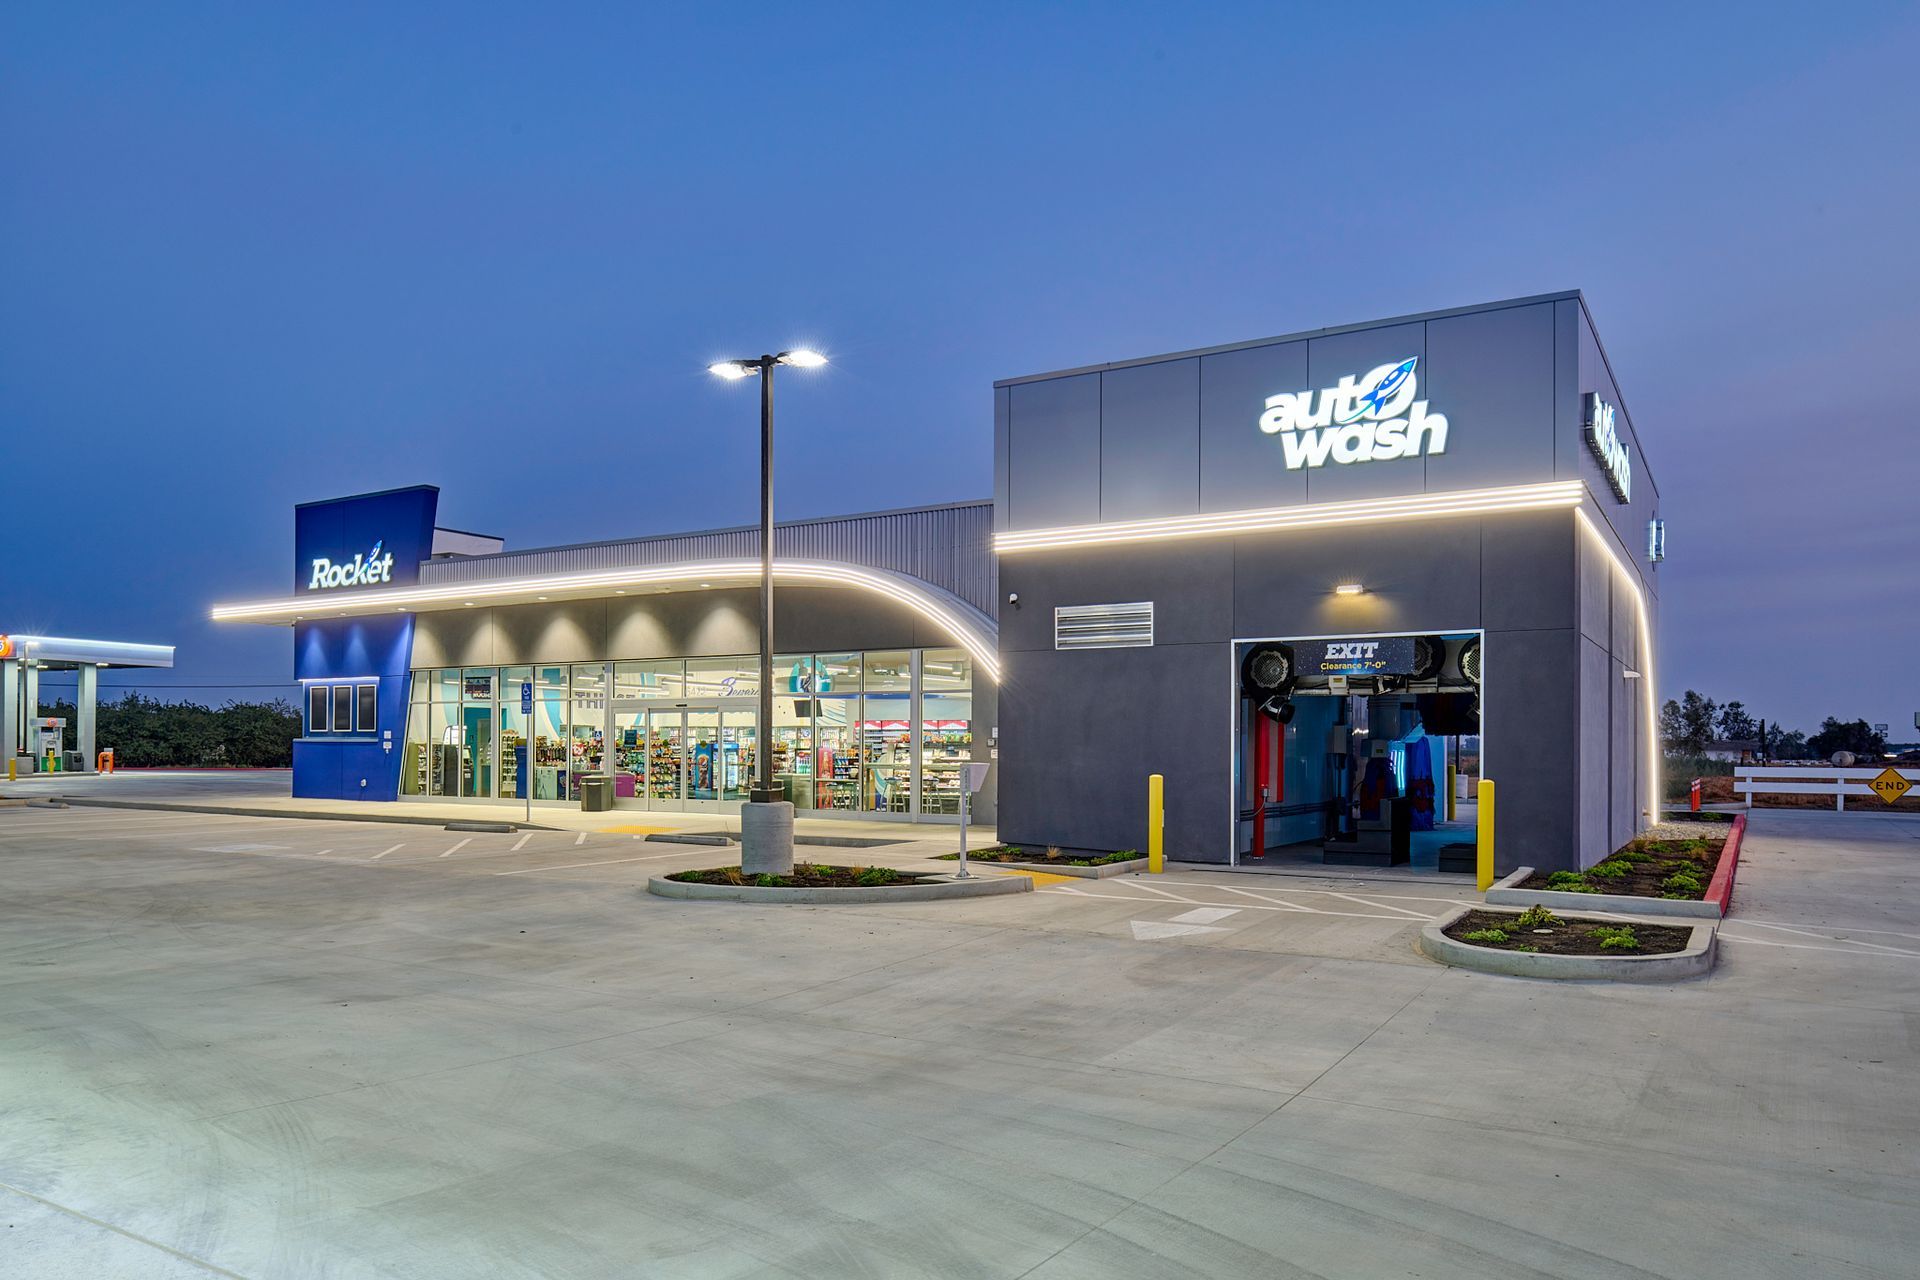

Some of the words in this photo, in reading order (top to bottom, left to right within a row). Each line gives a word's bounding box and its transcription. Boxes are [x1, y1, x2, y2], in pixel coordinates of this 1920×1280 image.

[1259, 361, 1418, 434] auto
[1280, 399, 1449, 471] wash
[308, 550, 394, 590] Rocket
[1324, 642, 1379, 660] EXIT
[1320, 662, 1362, 670] Clearance
[1876, 781, 1905, 791] END
